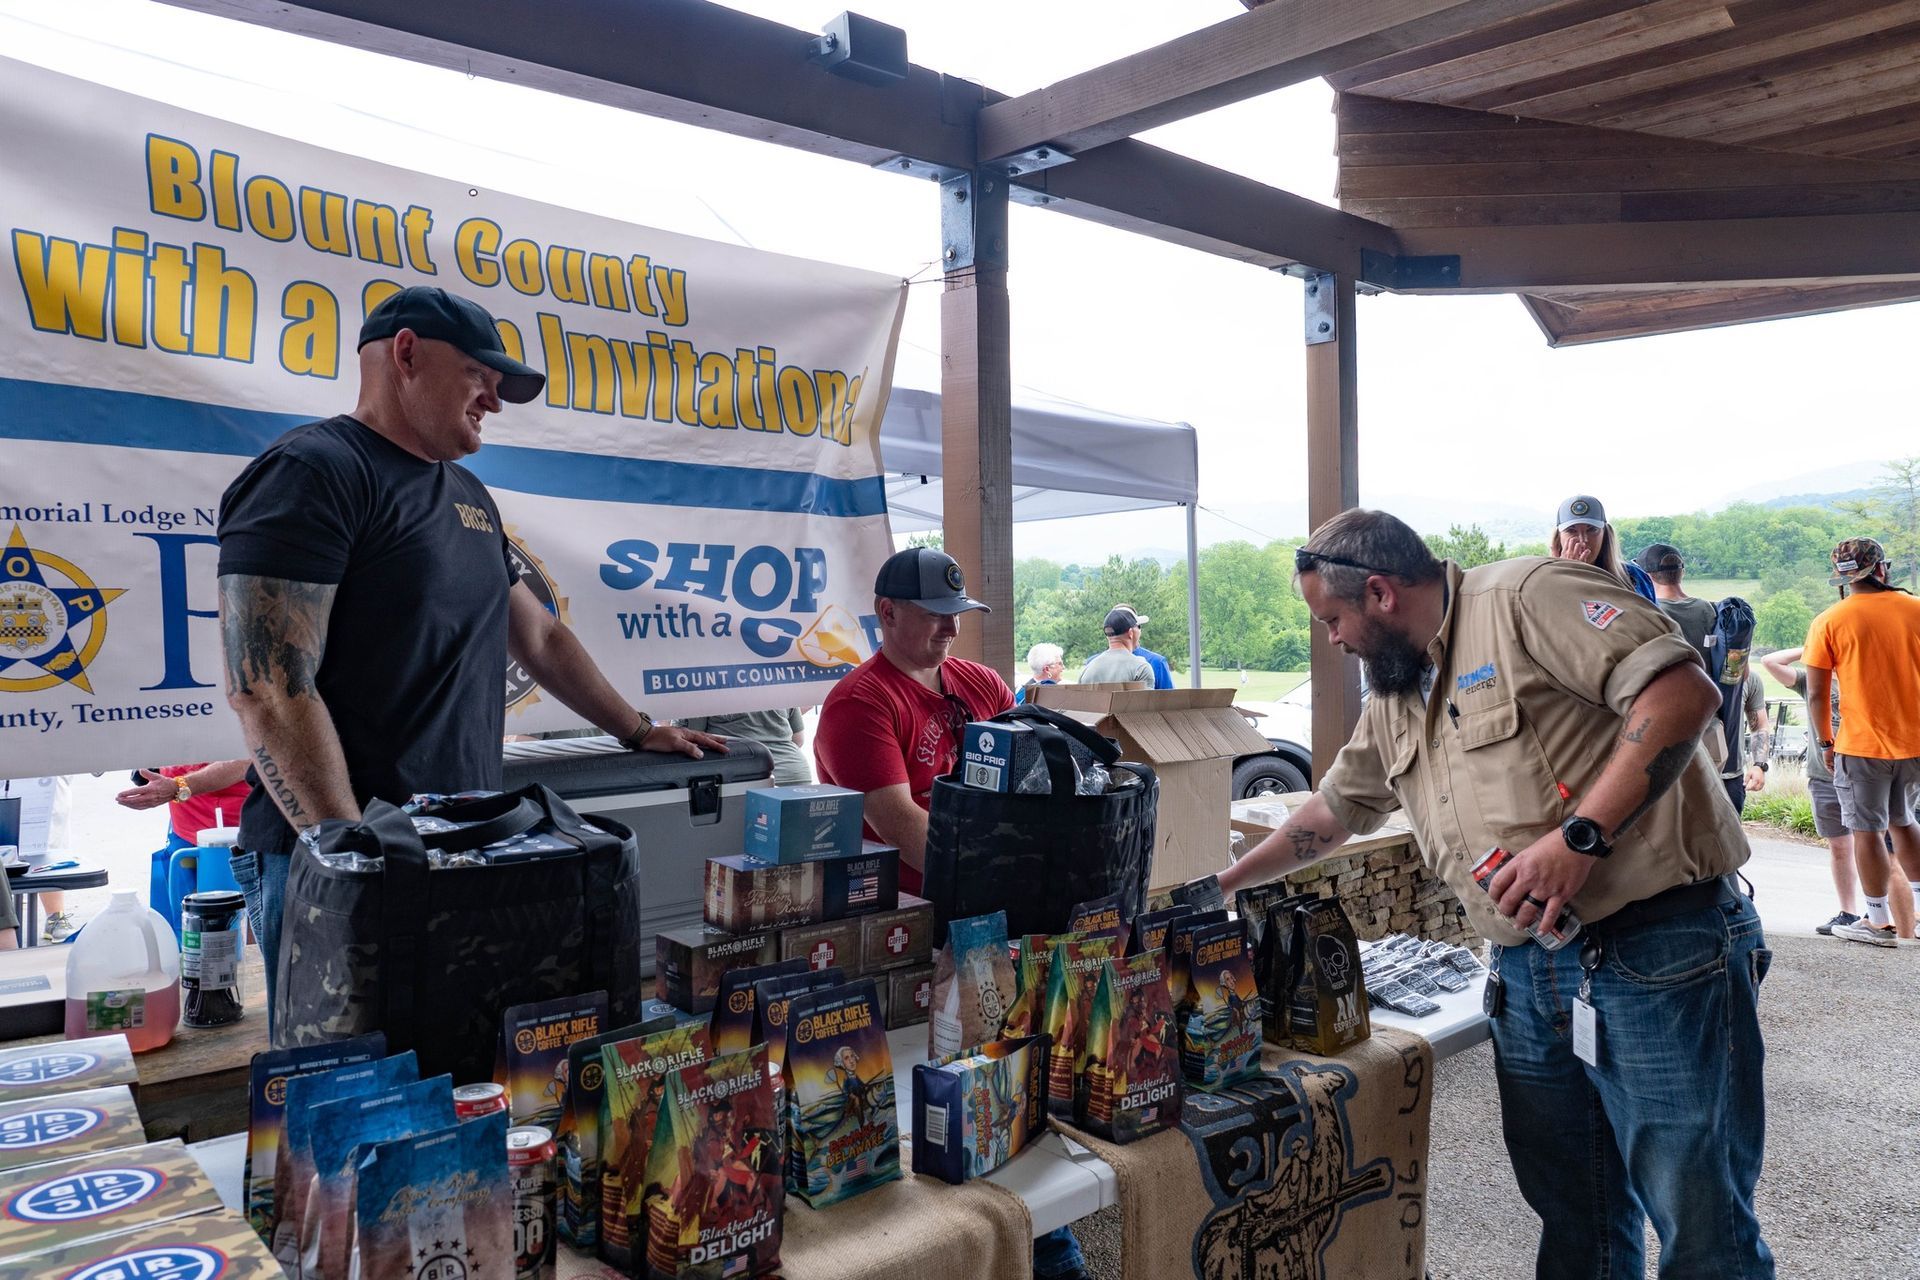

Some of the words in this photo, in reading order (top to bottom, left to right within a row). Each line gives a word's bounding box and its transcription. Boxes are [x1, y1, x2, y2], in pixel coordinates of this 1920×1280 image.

[145, 132, 437, 275] Blount
[454, 217, 689, 327] County
[11, 226, 258, 364] with
[279, 280, 340, 380] a
[537, 312, 868, 446] Invitation
[101, 503, 186, 531] Lodge
[454, 502, 494, 534] BRCC
[600, 539, 828, 613] SHOP
[617, 603, 704, 640] with
[711, 613, 732, 638] a
[651, 670, 729, 691] BLOUNT
[736, 664, 808, 684] COUNTY
[1465, 676, 1497, 695] energy
[71, 701, 214, 725] Tennessee
[965, 751, 982, 762] BIG
[983, 754, 1007, 767] FRIG
[847, 860, 865, 872] BLACK
[865, 858, 881, 870] RIFLE
[1085, 913, 1103, 925] BLACK
[1103, 909, 1120, 921] RIFLE
[707, 943, 733, 955] BLACK
[742, 936, 766, 948] RIFLE
[888, 934, 908, 945] COFFEE
[1207, 942, 1225, 954] BLACK
[1225, 937, 1242, 950] RIFLE
[813, 949, 833, 961] COFFEE
[1065, 960, 1084, 970] BLACK
[1113, 976, 1134, 987] BLACK
[1142, 967, 1161, 980] RIFLE
[535, 1021, 569, 1039] BLACK
[571, 1015, 599, 1032] RIFLE
[813, 1011, 842, 1029] BLACK
[844, 1002, 871, 1022] RIFLE
[1333, 1014, 1361, 1034] ESPRESSO
[814, 1025, 840, 1041] COFFEE
[840, 1016, 873, 1034] COMPANY
[537, 1037, 561, 1052] COFFEE
[615, 1060, 652, 1079] BLACK
[667, 1047, 705, 1066] RIFLE
[677, 1087, 715, 1105] BLACK
[729, 1069, 763, 1090] RIFLE
[729, 1079, 763, 1096] COMPANY
[1121, 1082, 1176, 1111] DELIGHT
[826, 1133, 885, 1168] DELAWARE
[519, 1176, 544, 1189] RIFLE
[699, 1208, 769, 1243] Blackbeard's
[690, 1218, 776, 1266] DELIGHT
